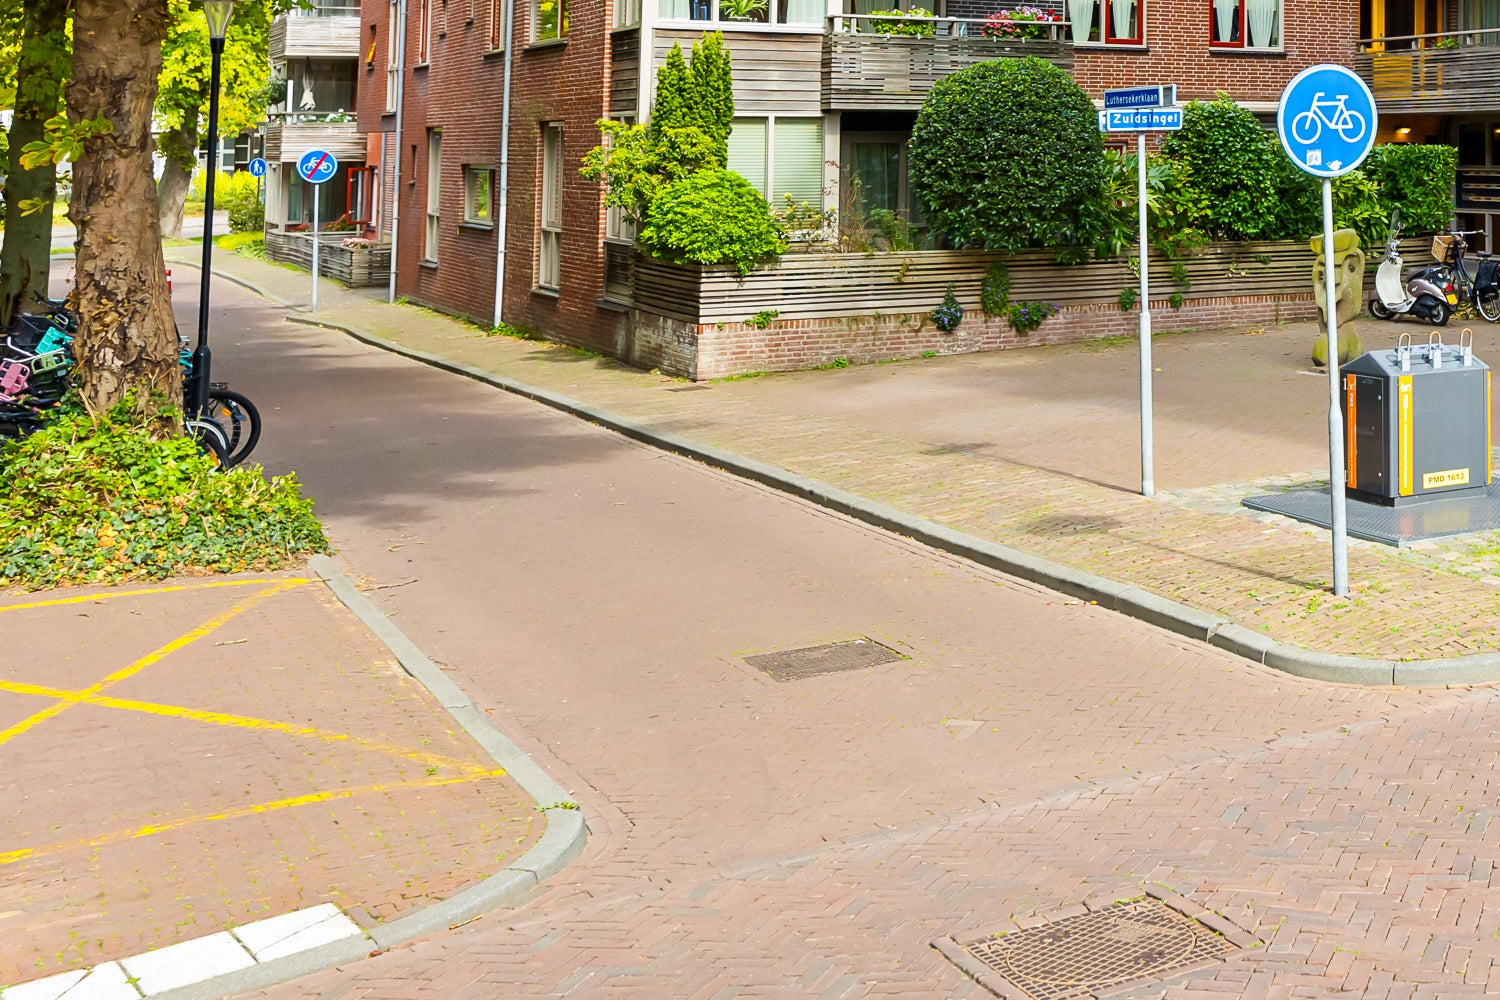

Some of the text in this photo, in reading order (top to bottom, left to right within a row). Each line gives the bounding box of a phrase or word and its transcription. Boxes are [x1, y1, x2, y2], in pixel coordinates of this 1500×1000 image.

[1106, 93, 1158, 105] Luthersekerklaan
[1113, 113, 1178, 125] Zuidsingel
[1428, 475, 1444, 483] PMD
